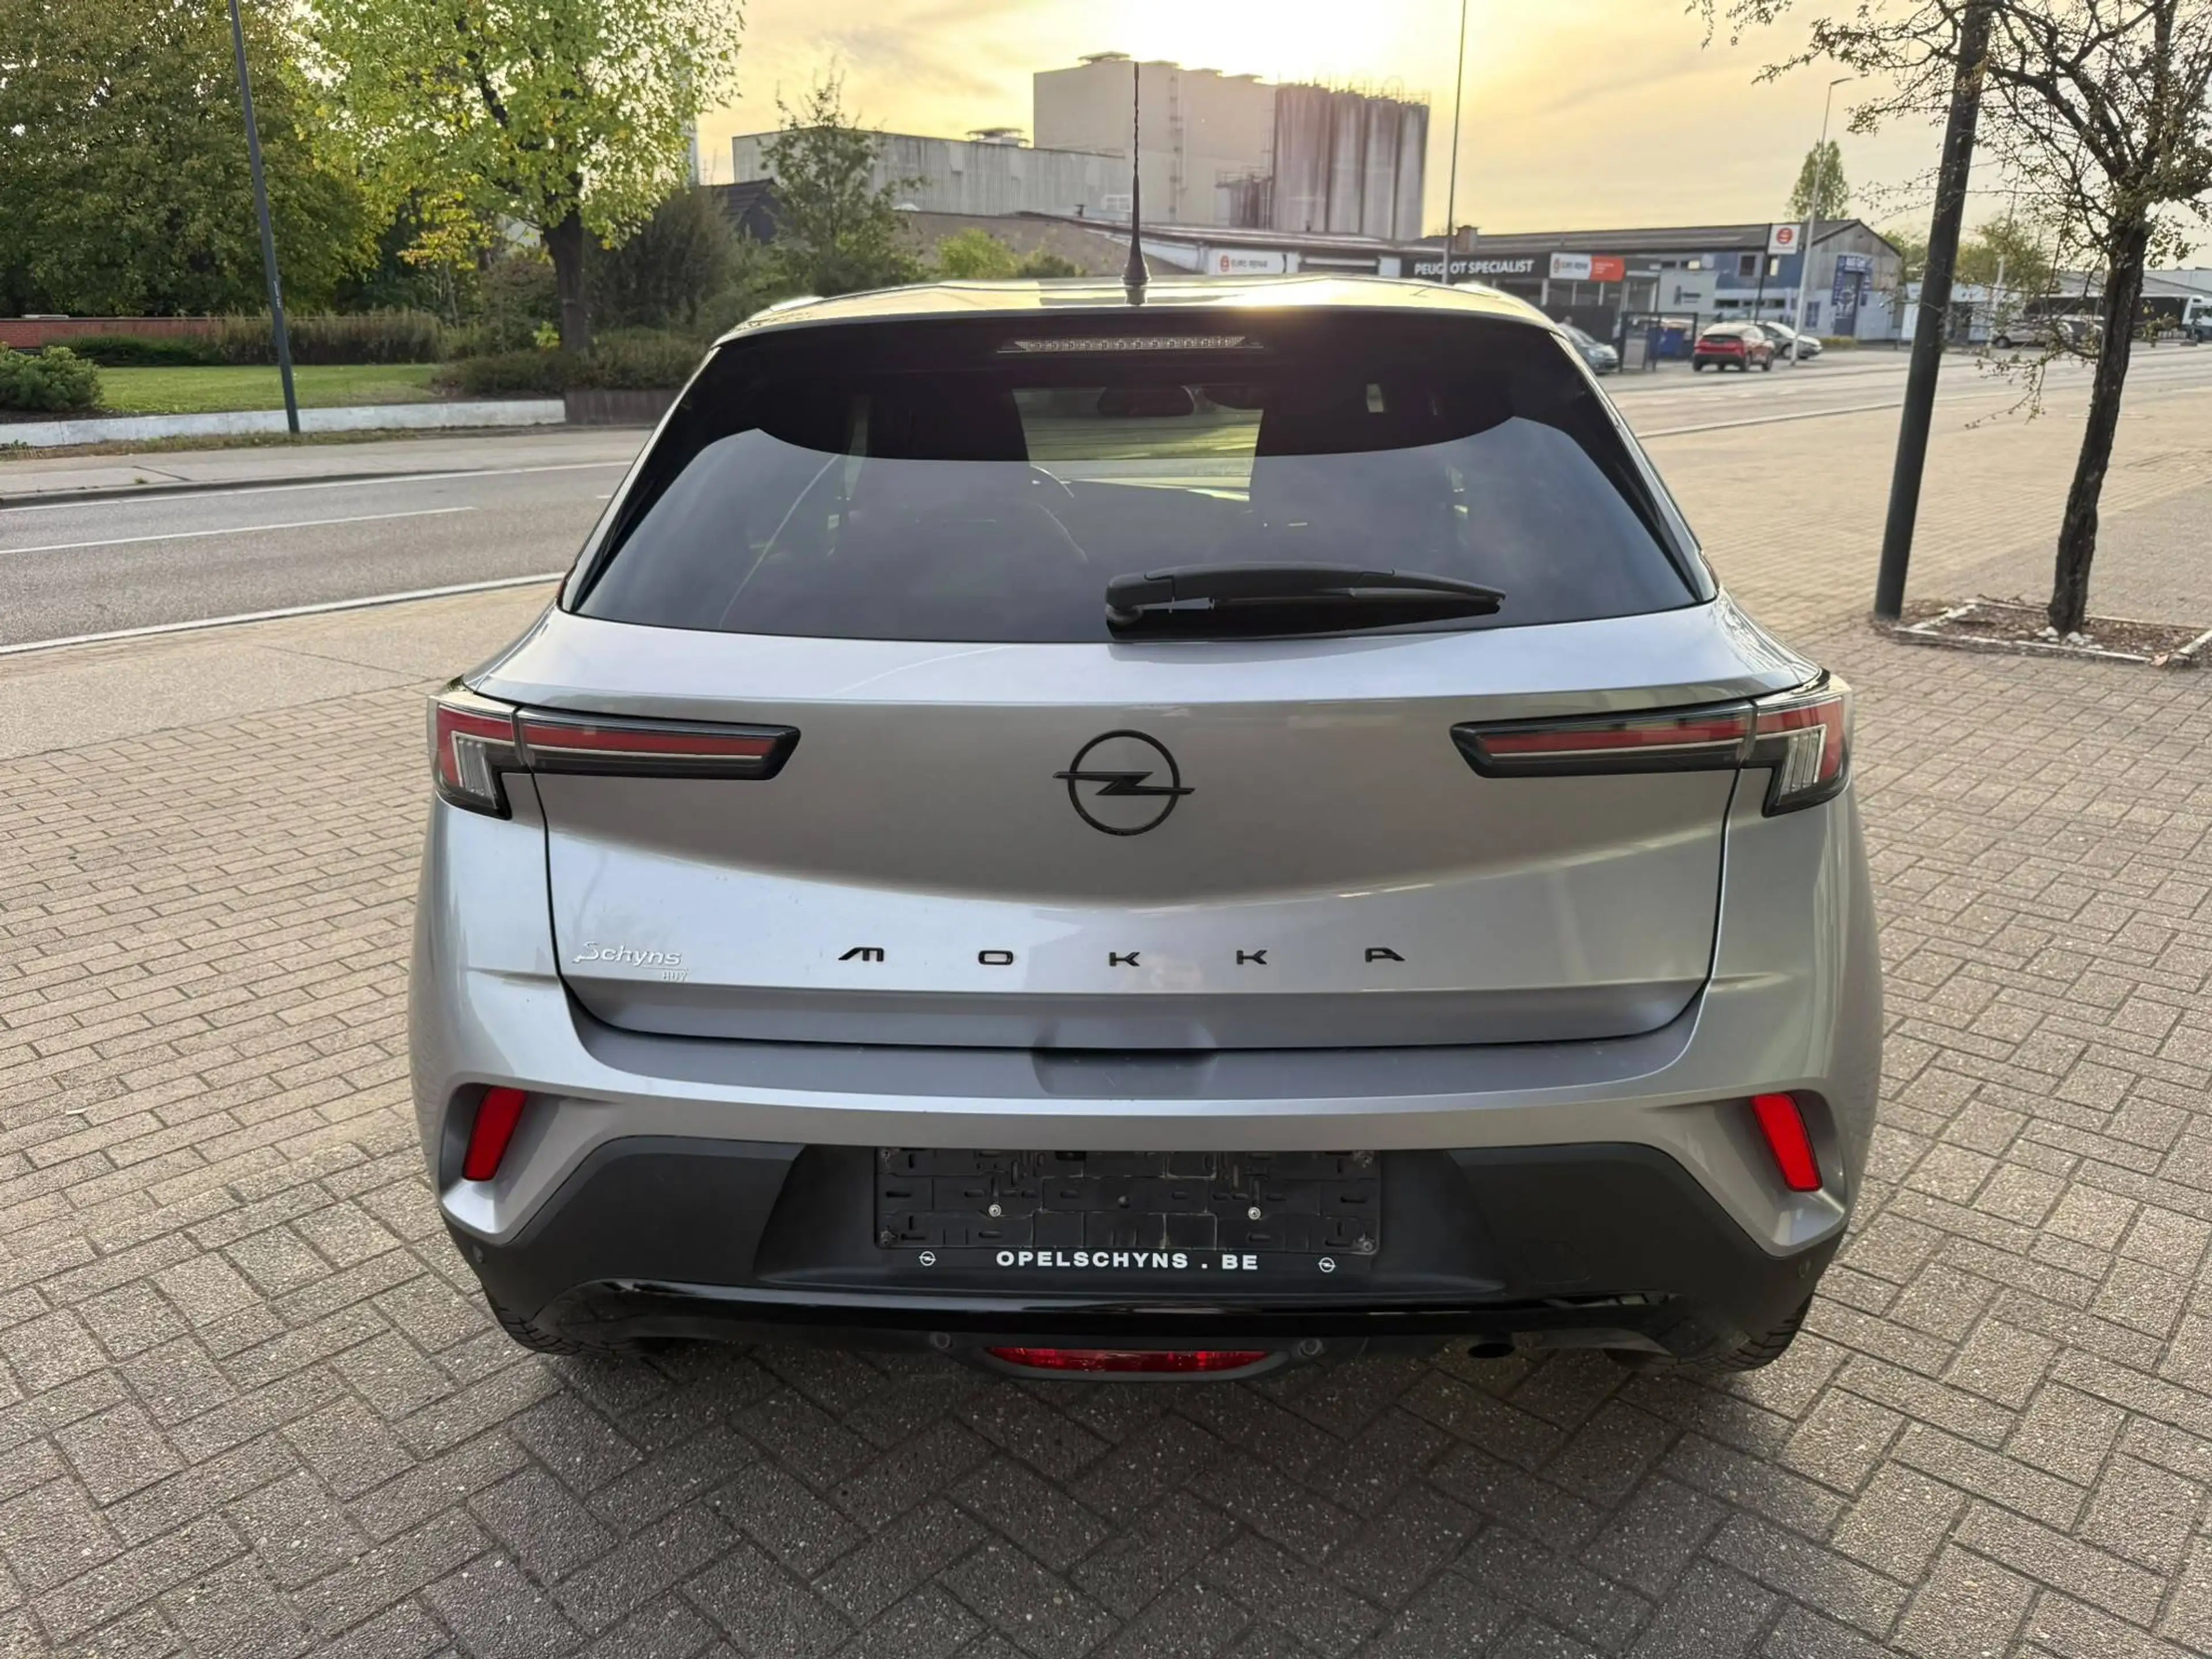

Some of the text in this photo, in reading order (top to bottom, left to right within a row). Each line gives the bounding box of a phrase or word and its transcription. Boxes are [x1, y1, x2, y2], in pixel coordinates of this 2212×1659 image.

[1414, 259, 1535, 276] PEUGOT SPECIALIST
[571, 941, 682, 967] Schyns
[838, 947, 1406, 967] MOKKA
[995, 1251, 1188, 1269] OPELSCHYNS
[1222, 1254, 1258, 1270] BE
